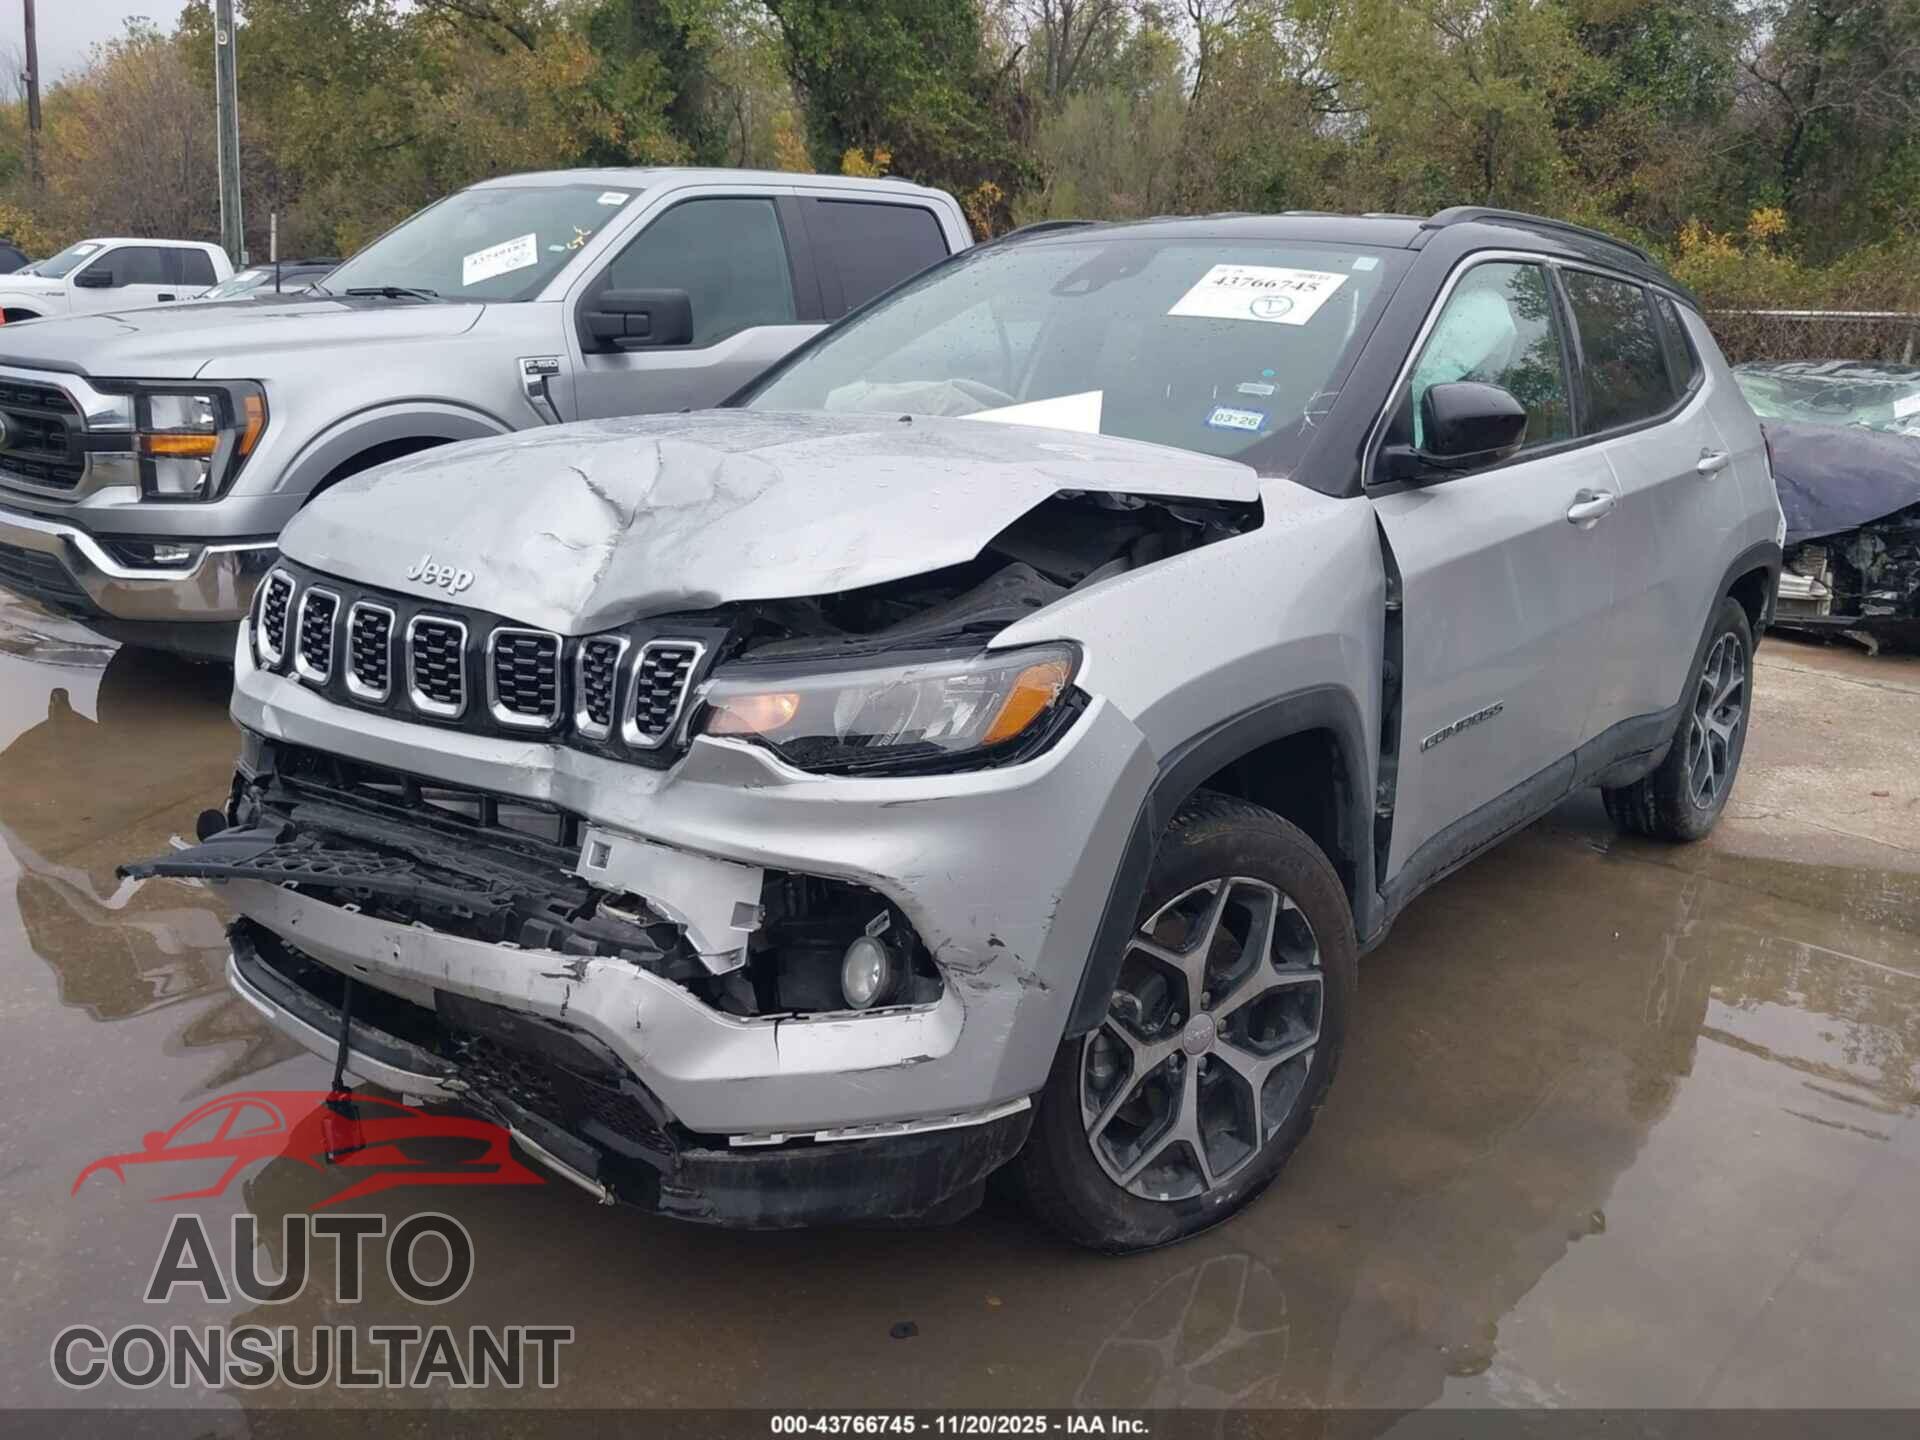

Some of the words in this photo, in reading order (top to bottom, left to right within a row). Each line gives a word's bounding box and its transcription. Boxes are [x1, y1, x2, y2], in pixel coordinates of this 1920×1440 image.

[1212, 276, 1321, 292] 43766745
[1214, 412, 1259, 427] 03-26
[407, 554, 475, 596] Jeep
